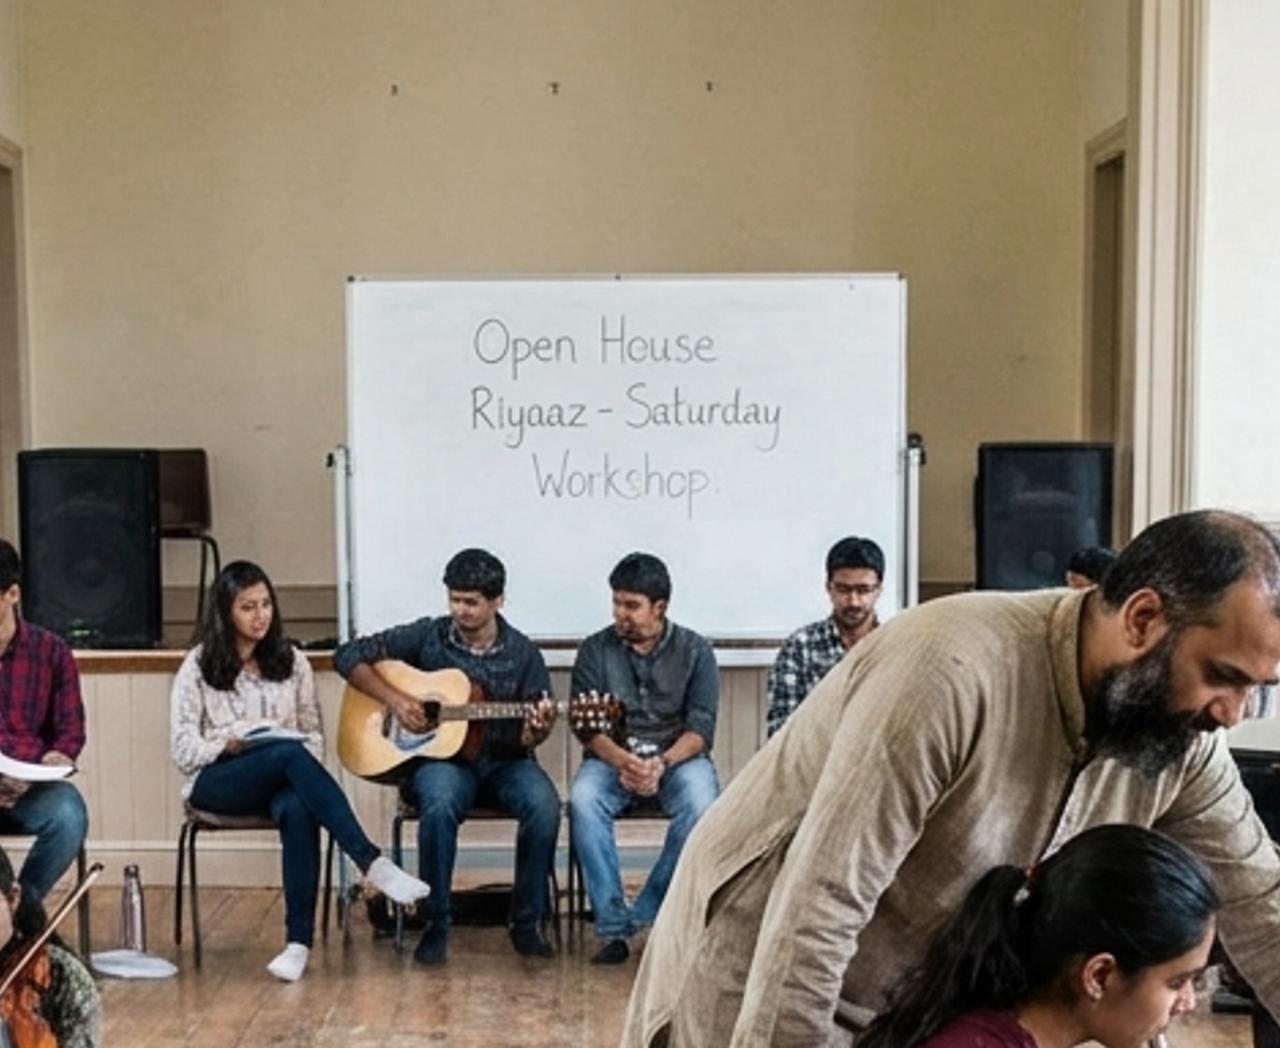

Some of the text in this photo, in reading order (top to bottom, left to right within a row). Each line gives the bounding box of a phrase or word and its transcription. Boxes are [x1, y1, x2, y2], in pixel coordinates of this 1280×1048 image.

[473, 314, 719, 381] Open House
[625, 381, 782, 453] Saturday
